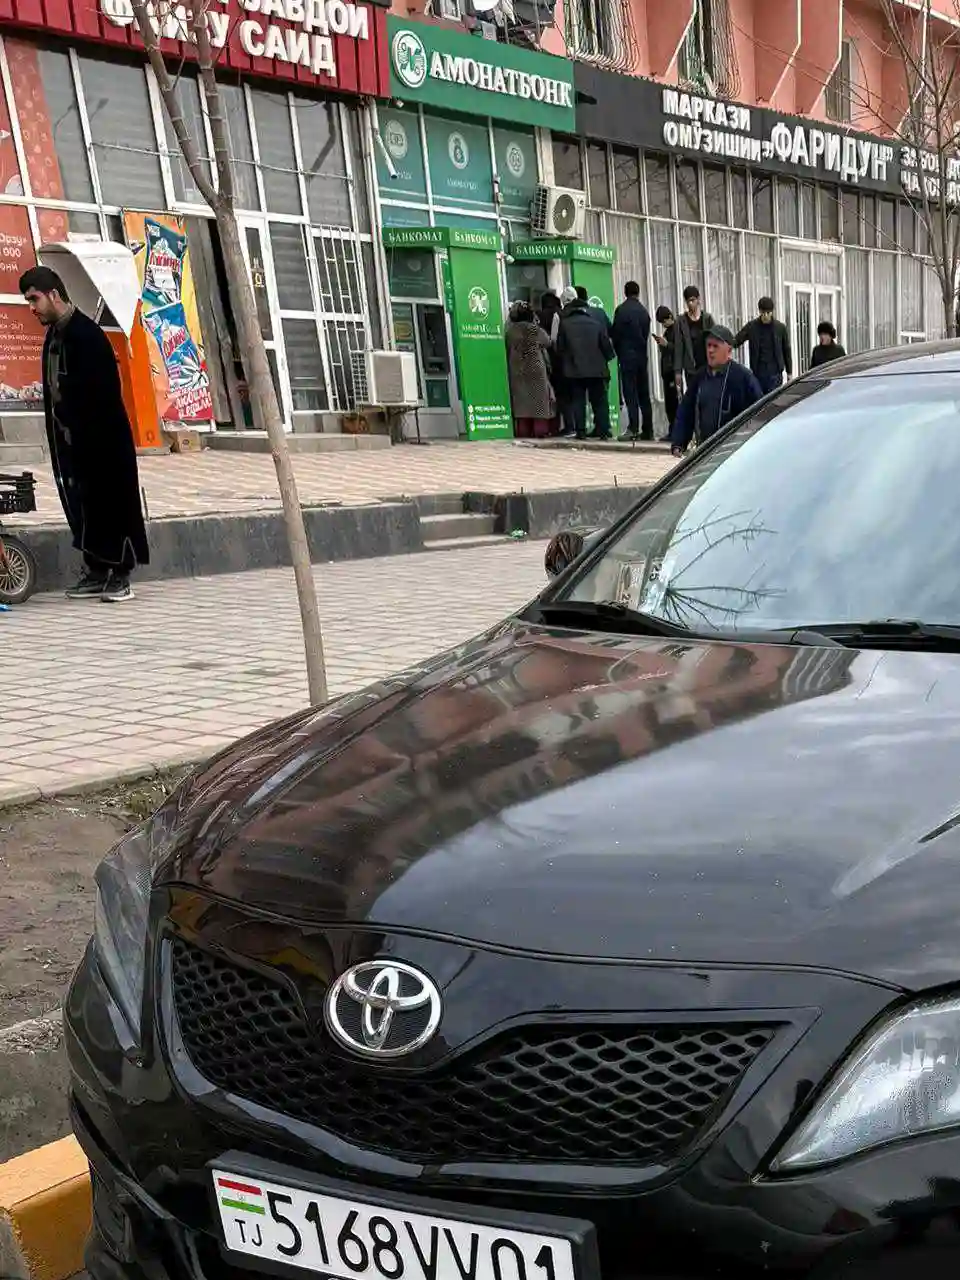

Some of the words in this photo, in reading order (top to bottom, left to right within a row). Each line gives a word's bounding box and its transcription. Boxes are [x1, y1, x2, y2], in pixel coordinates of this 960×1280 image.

[240, 20, 337, 77] САИД
[429, 51, 573, 108] АМОНАТБОНК
[662, 89, 751, 131] МАРКАЗИ
[388, 230, 443, 243] БАНКОМАТ
[454, 231, 498, 248] БАНКОМАТ
[515, 244, 569, 257] БАНКОМАТ
[234, 1218, 264, 1247] TJ
